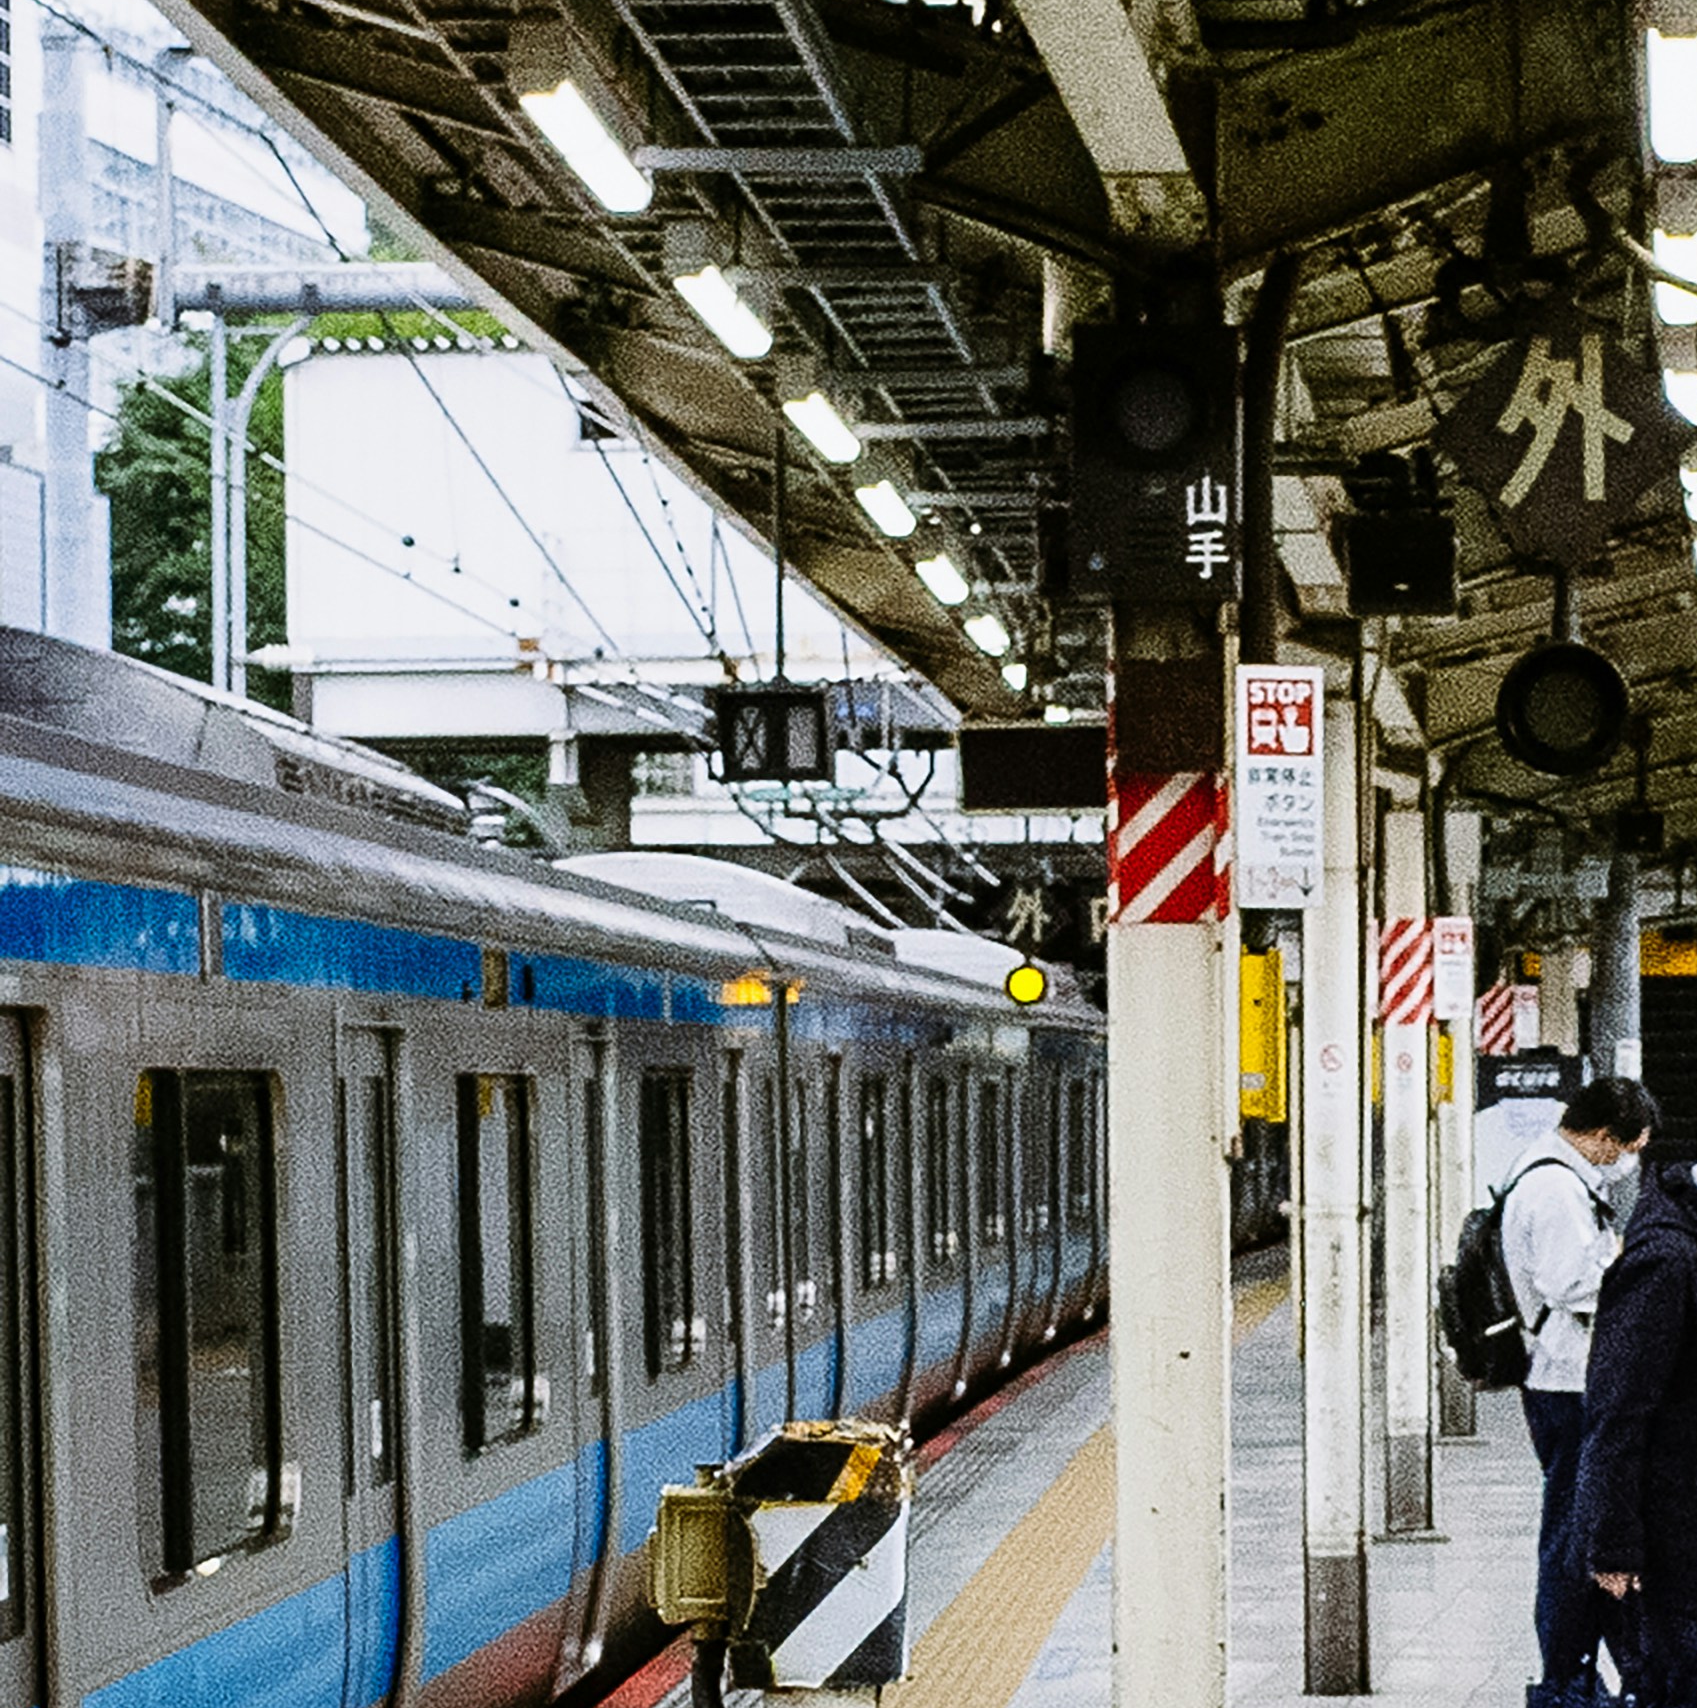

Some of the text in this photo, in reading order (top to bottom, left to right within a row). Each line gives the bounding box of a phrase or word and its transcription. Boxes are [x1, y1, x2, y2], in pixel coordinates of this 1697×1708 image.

[1497, 334, 1635, 508] 外
[1185, 474, 1230, 579] 山手
[1250, 681, 1312, 705] STOP
[1006, 888, 1051, 941] 外
